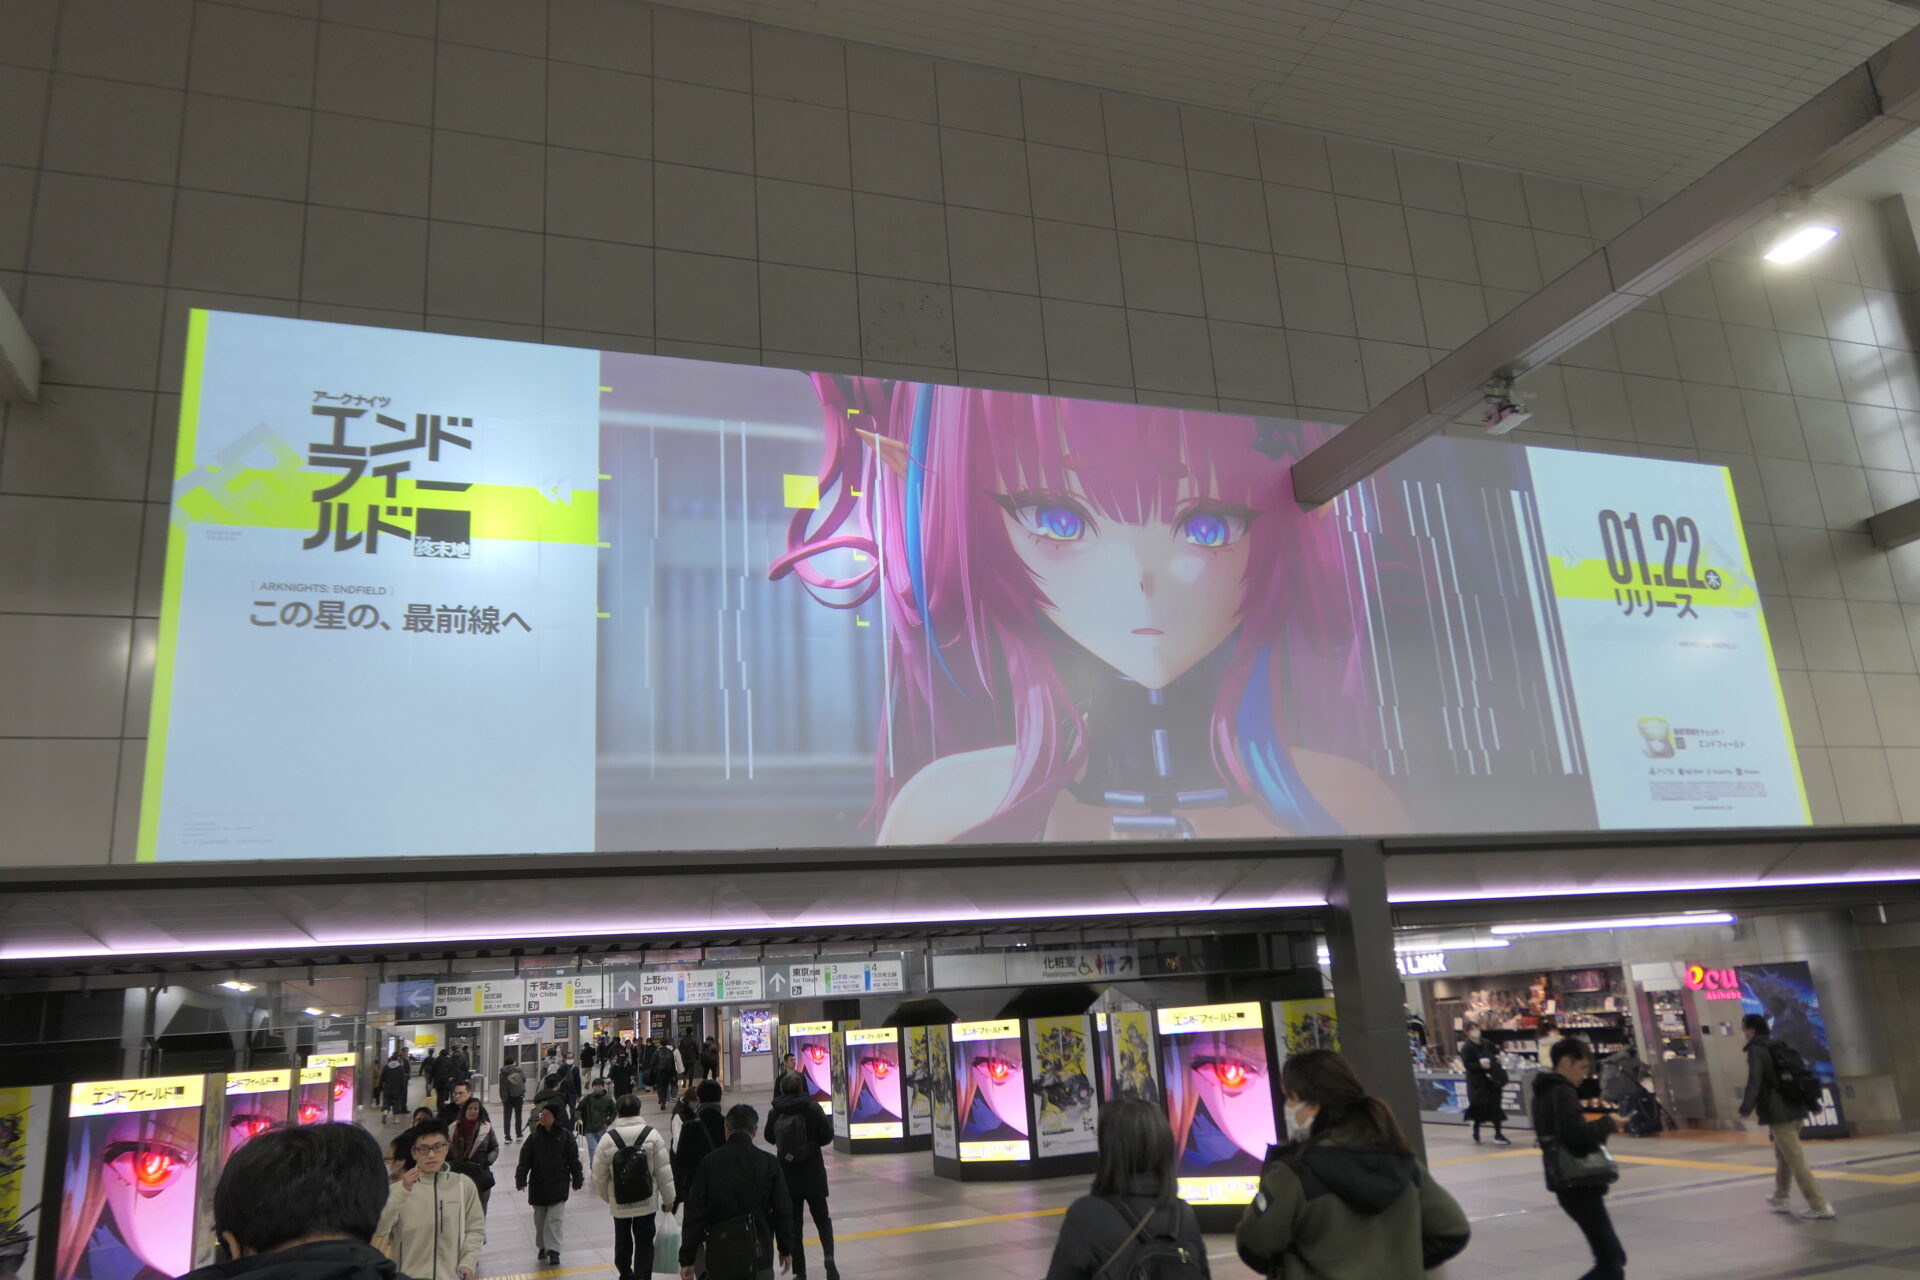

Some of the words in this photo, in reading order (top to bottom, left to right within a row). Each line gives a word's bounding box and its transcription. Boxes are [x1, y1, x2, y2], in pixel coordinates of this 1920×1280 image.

[312, 390, 391, 408] アークナイツ
[308, 404, 474, 462] エンド
[1598, 509, 1707, 589] 01.22
[259, 581, 329, 593] ARKNIGHTS:
[333, 584, 386, 595] ENDFIELD
[1614, 588, 1699, 619] リリース
[249, 599, 532, 635] この星の、最前線へ
[872, 963, 877, 971] 4
[1043, 956, 1076, 969] 化粧室
[832, 965, 838, 974] 3
[1042, 970, 1077, 979] Restrooms
[644, 976, 674, 985] 上野方面
[686, 972, 691, 981] 1
[725, 971, 731, 980] 2
[484, 983, 491, 992] 5
[530, 981, 563, 991] 千葉方面
[574, 978, 581, 987] 6
[437, 986, 472, 996] 新宿方面
[92, 1087, 175, 1106] エンドフィールド
